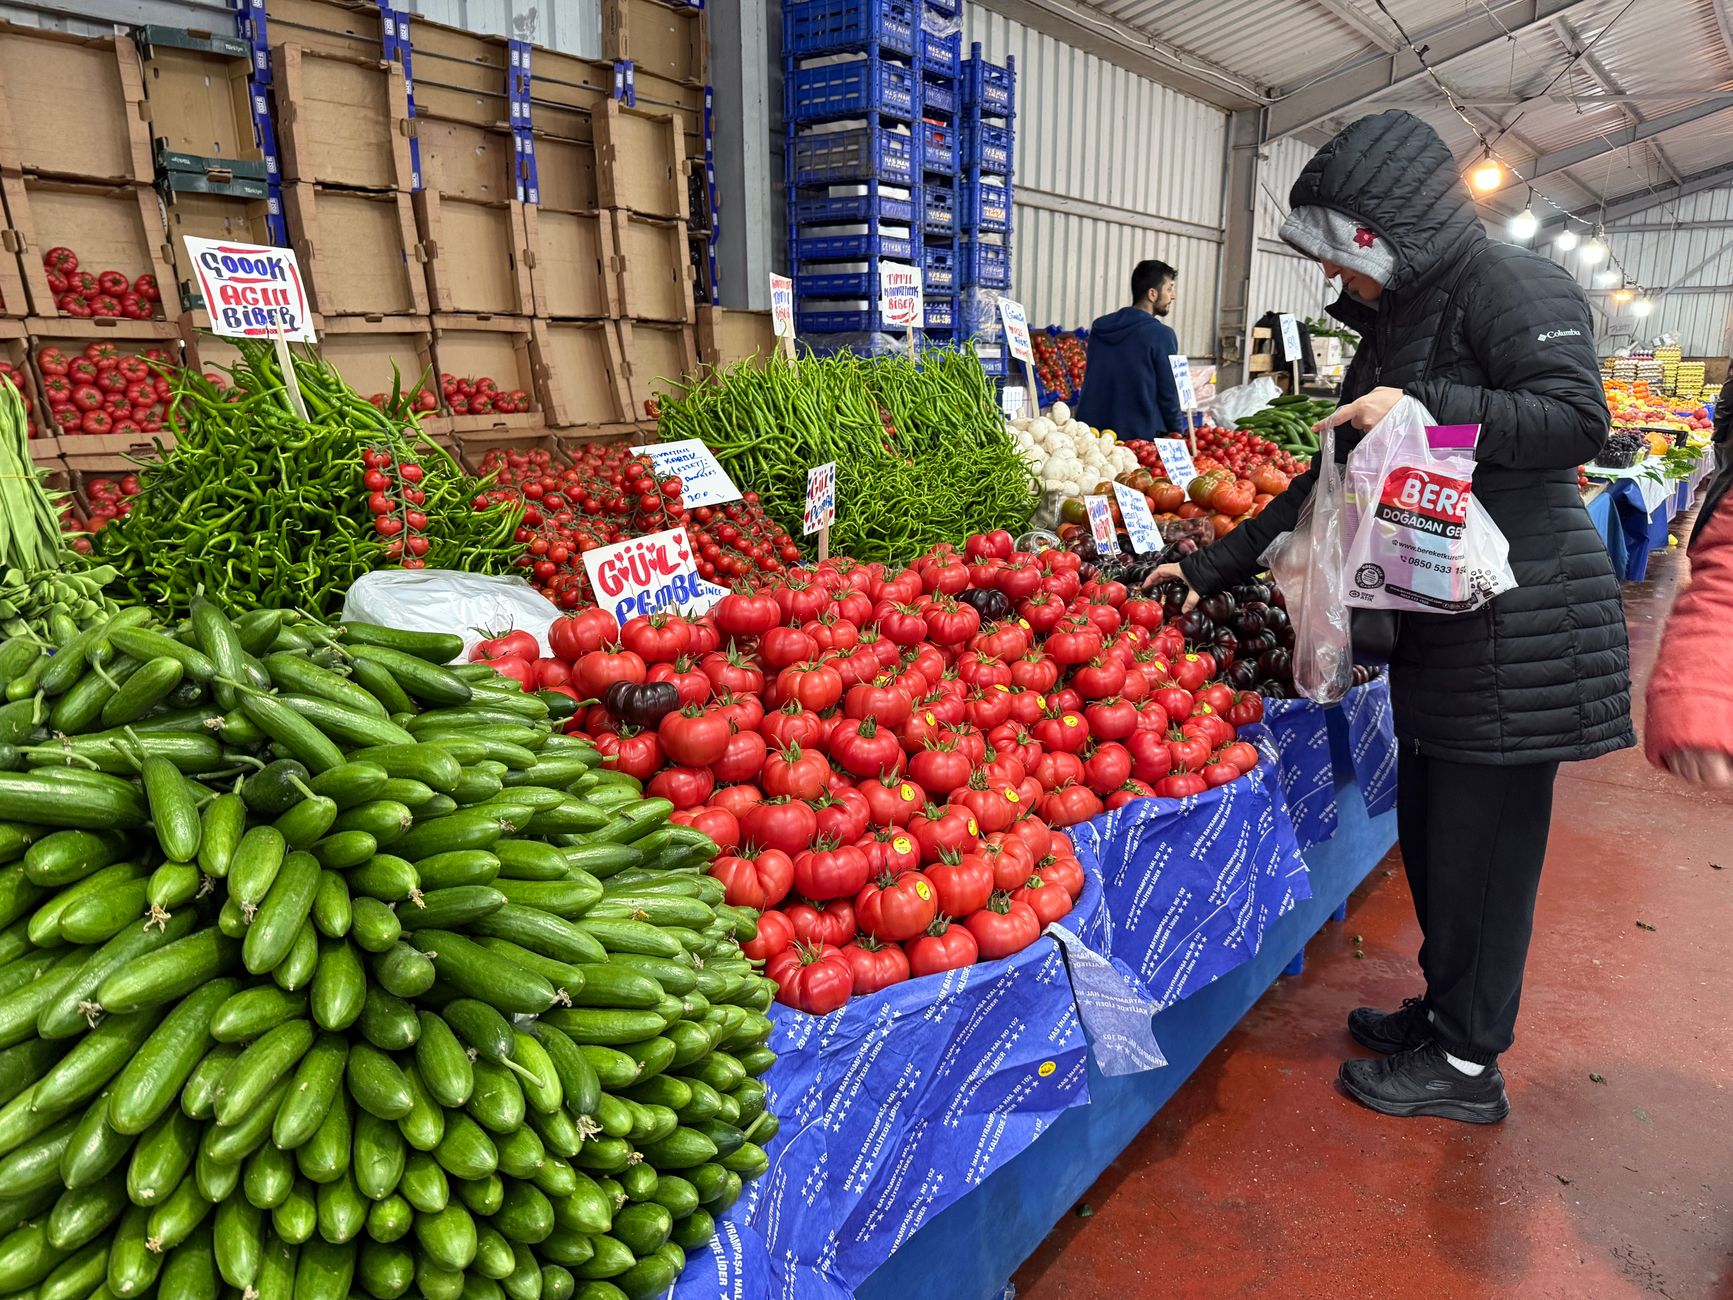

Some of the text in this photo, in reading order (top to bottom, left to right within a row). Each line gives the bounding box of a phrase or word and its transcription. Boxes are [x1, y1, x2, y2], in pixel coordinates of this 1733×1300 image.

[888, 297, 914, 312] BİBER
[222, 306, 299, 331] BİBER
[1546, 328, 1581, 338] Columbia
[810, 470, 828, 500] GÜL
[1400, 478, 1470, 517] BERE
[1382, 508, 1443, 534] DOĞADAN
[598, 542, 681, 597] GÜL
[1408, 557, 1452, 574] 0850 533
[616, 570, 704, 628] PEMBE
[1005, 963, 1015, 977] 102
[881, 1003, 890, 1017] 102
[924, 1006, 936, 1020] HAS
[1048, 1027, 1060, 1041] HAS
[943, 1111, 953, 1126] HAS
[991, 1040, 1002, 1051] HAL
[1001, 1029, 1009, 1039] NO
[1009, 1017, 1019, 1028] 102
[843, 1175, 854, 1191] HAS
[887, 1090, 898, 1103] HAL
[897, 1078, 905, 1089] NO
[904, 1063, 913, 1077] 102
[965, 1168, 974, 1183] HAS
[1003, 1094, 1014, 1104] HAL
[1013, 1085, 1022, 1094] NO
[1021, 1074, 1033, 1084] 102
[912, 1196, 924, 1208] HAL
[920, 1183, 928, 1194] NO
[926, 1168, 935, 1181] 102
